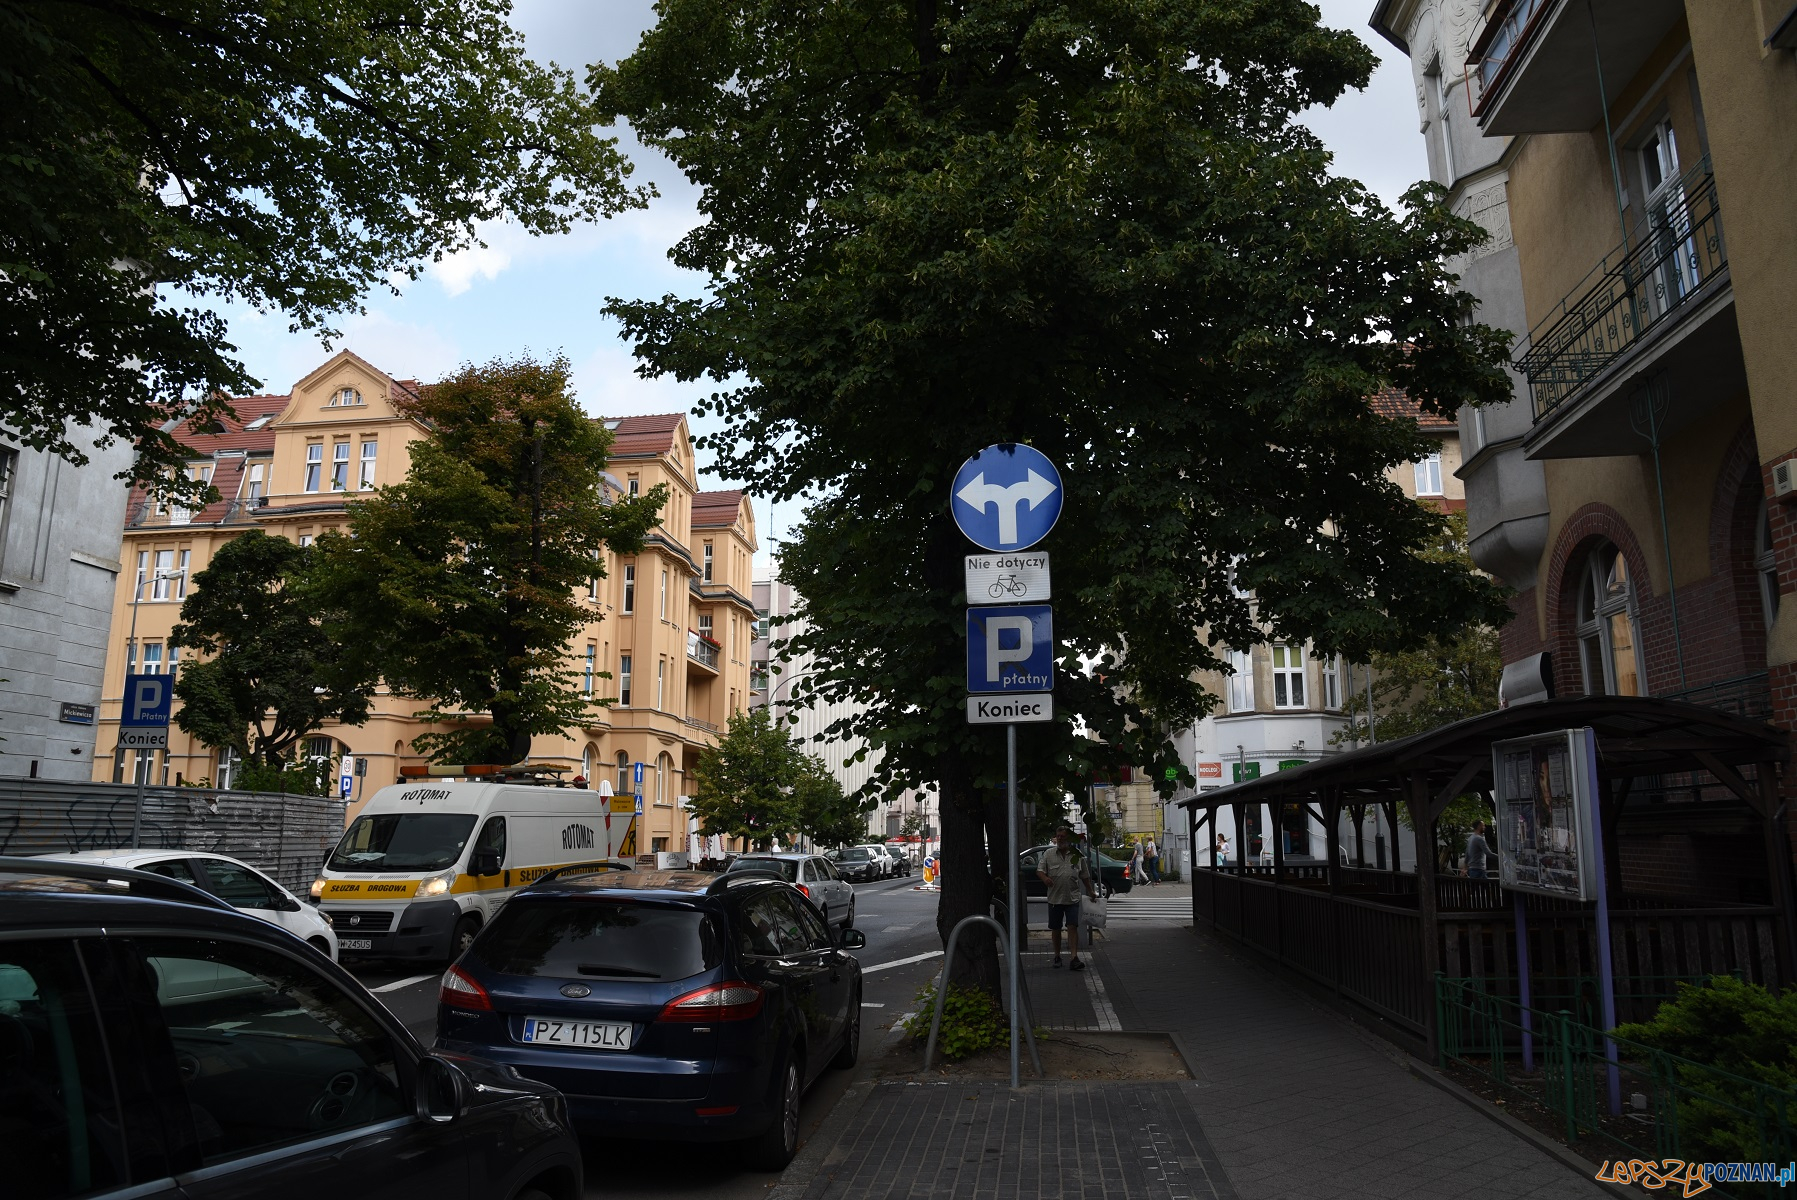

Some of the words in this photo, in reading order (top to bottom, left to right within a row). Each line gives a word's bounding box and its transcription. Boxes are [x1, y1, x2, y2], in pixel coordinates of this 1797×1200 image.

[968, 558, 990, 569] Nie
[996, 557, 1045, 570] dotyczy
[986, 616, 1033, 682] P
[1003, 673, 1048, 688] płatny
[133, 681, 162, 720] P
[978, 700, 1041, 717] Koniec
[142, 712, 167, 722] Płatny
[120, 731, 165, 744] Koniec
[400, 789, 452, 801] ROTOMAT
[562, 823, 594, 849] ROTOMAT
[330, 884, 360, 892] SŁUŻBA
[367, 884, 406, 892] DROGOWA
[535, 1022, 563, 1041] PZ
[571, 1024, 628, 1046] 115LK
